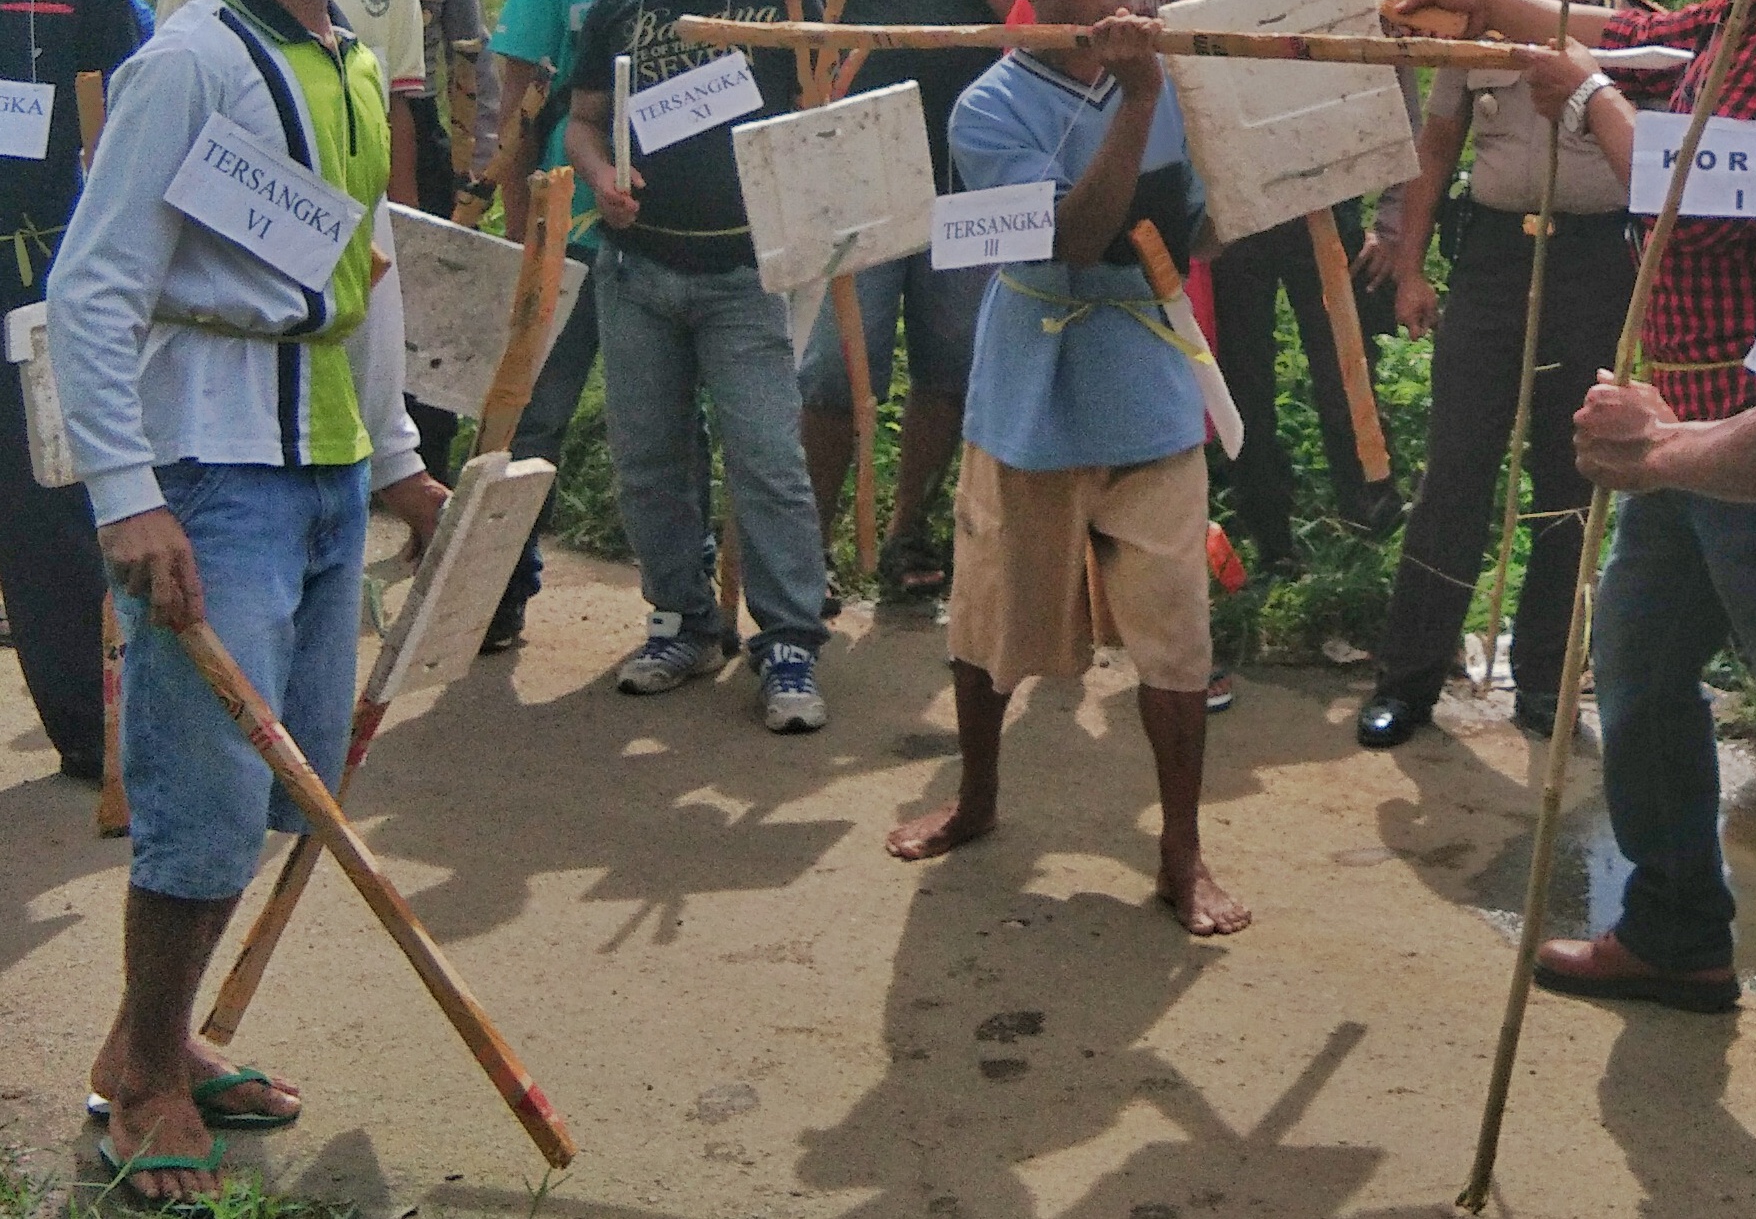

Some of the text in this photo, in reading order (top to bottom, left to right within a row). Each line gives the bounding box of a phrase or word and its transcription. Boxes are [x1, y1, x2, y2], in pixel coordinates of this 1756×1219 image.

[636, 70, 749, 122] TERSANGKA
[690, 103, 713, 122] XI
[203, 139, 342, 242] TERSANGKA
[1735, 189, 1744, 210] I
[247, 208, 273, 239] VI
[944, 210, 1053, 240] TERSANGKA
[984, 238, 999, 257] III
